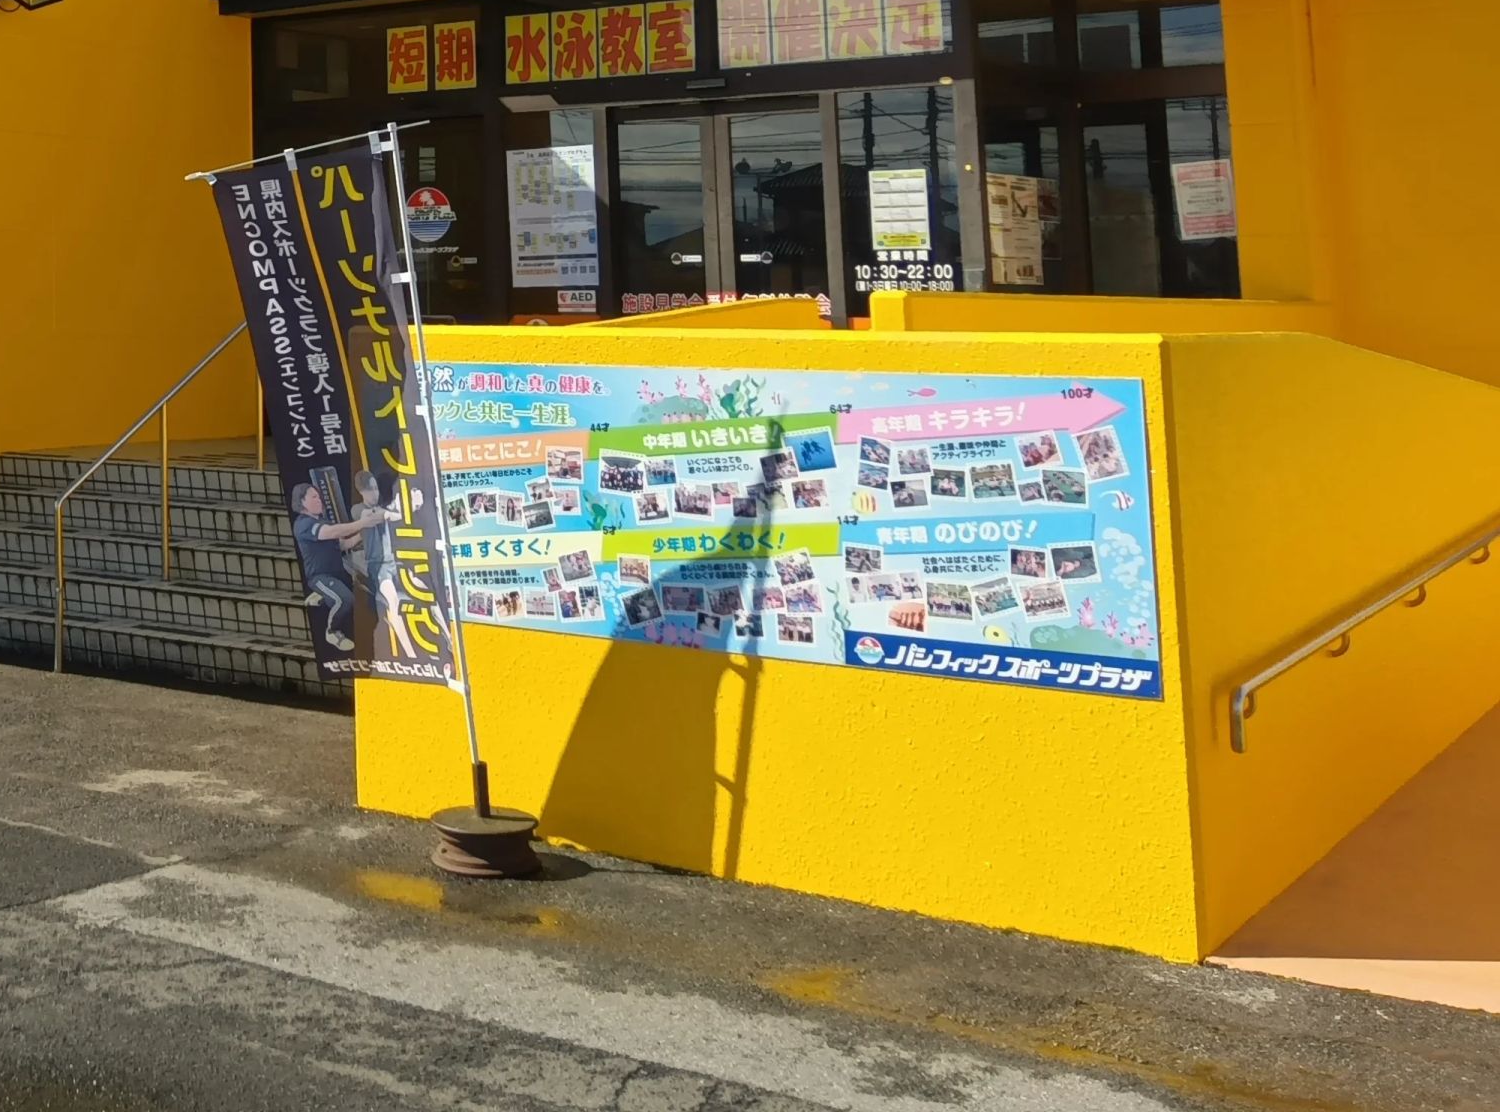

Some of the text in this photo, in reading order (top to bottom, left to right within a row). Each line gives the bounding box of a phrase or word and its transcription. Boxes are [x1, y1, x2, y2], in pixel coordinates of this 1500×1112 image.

[388, 27, 476, 85] 短期
[507, 4, 694, 82] 水泳教室
[877, 250, 929, 262] 営業時間
[570, 293, 593, 302] AED
[1060, 387, 1094, 399] 100才
[829, 404, 852, 415] 64才
[871, 402, 1026, 434] 高年期 キラキラ!
[590, 423, 610, 432] 44才
[643, 424, 779, 450] 中年期 いきいき!
[467, 440, 542, 463] にこにこ!
[686, 455, 742, 466] いくつになっても
[836, 515, 860, 526] 14才
[602, 525, 617, 536] 5才
[876, 519, 1038, 545] 青年期 のびのび!
[476, 538, 553, 558] すくすく!
[652, 532, 785, 553] 少年期 わくわく!
[884, 642, 1153, 691] パシフィック スポーツプラザ
